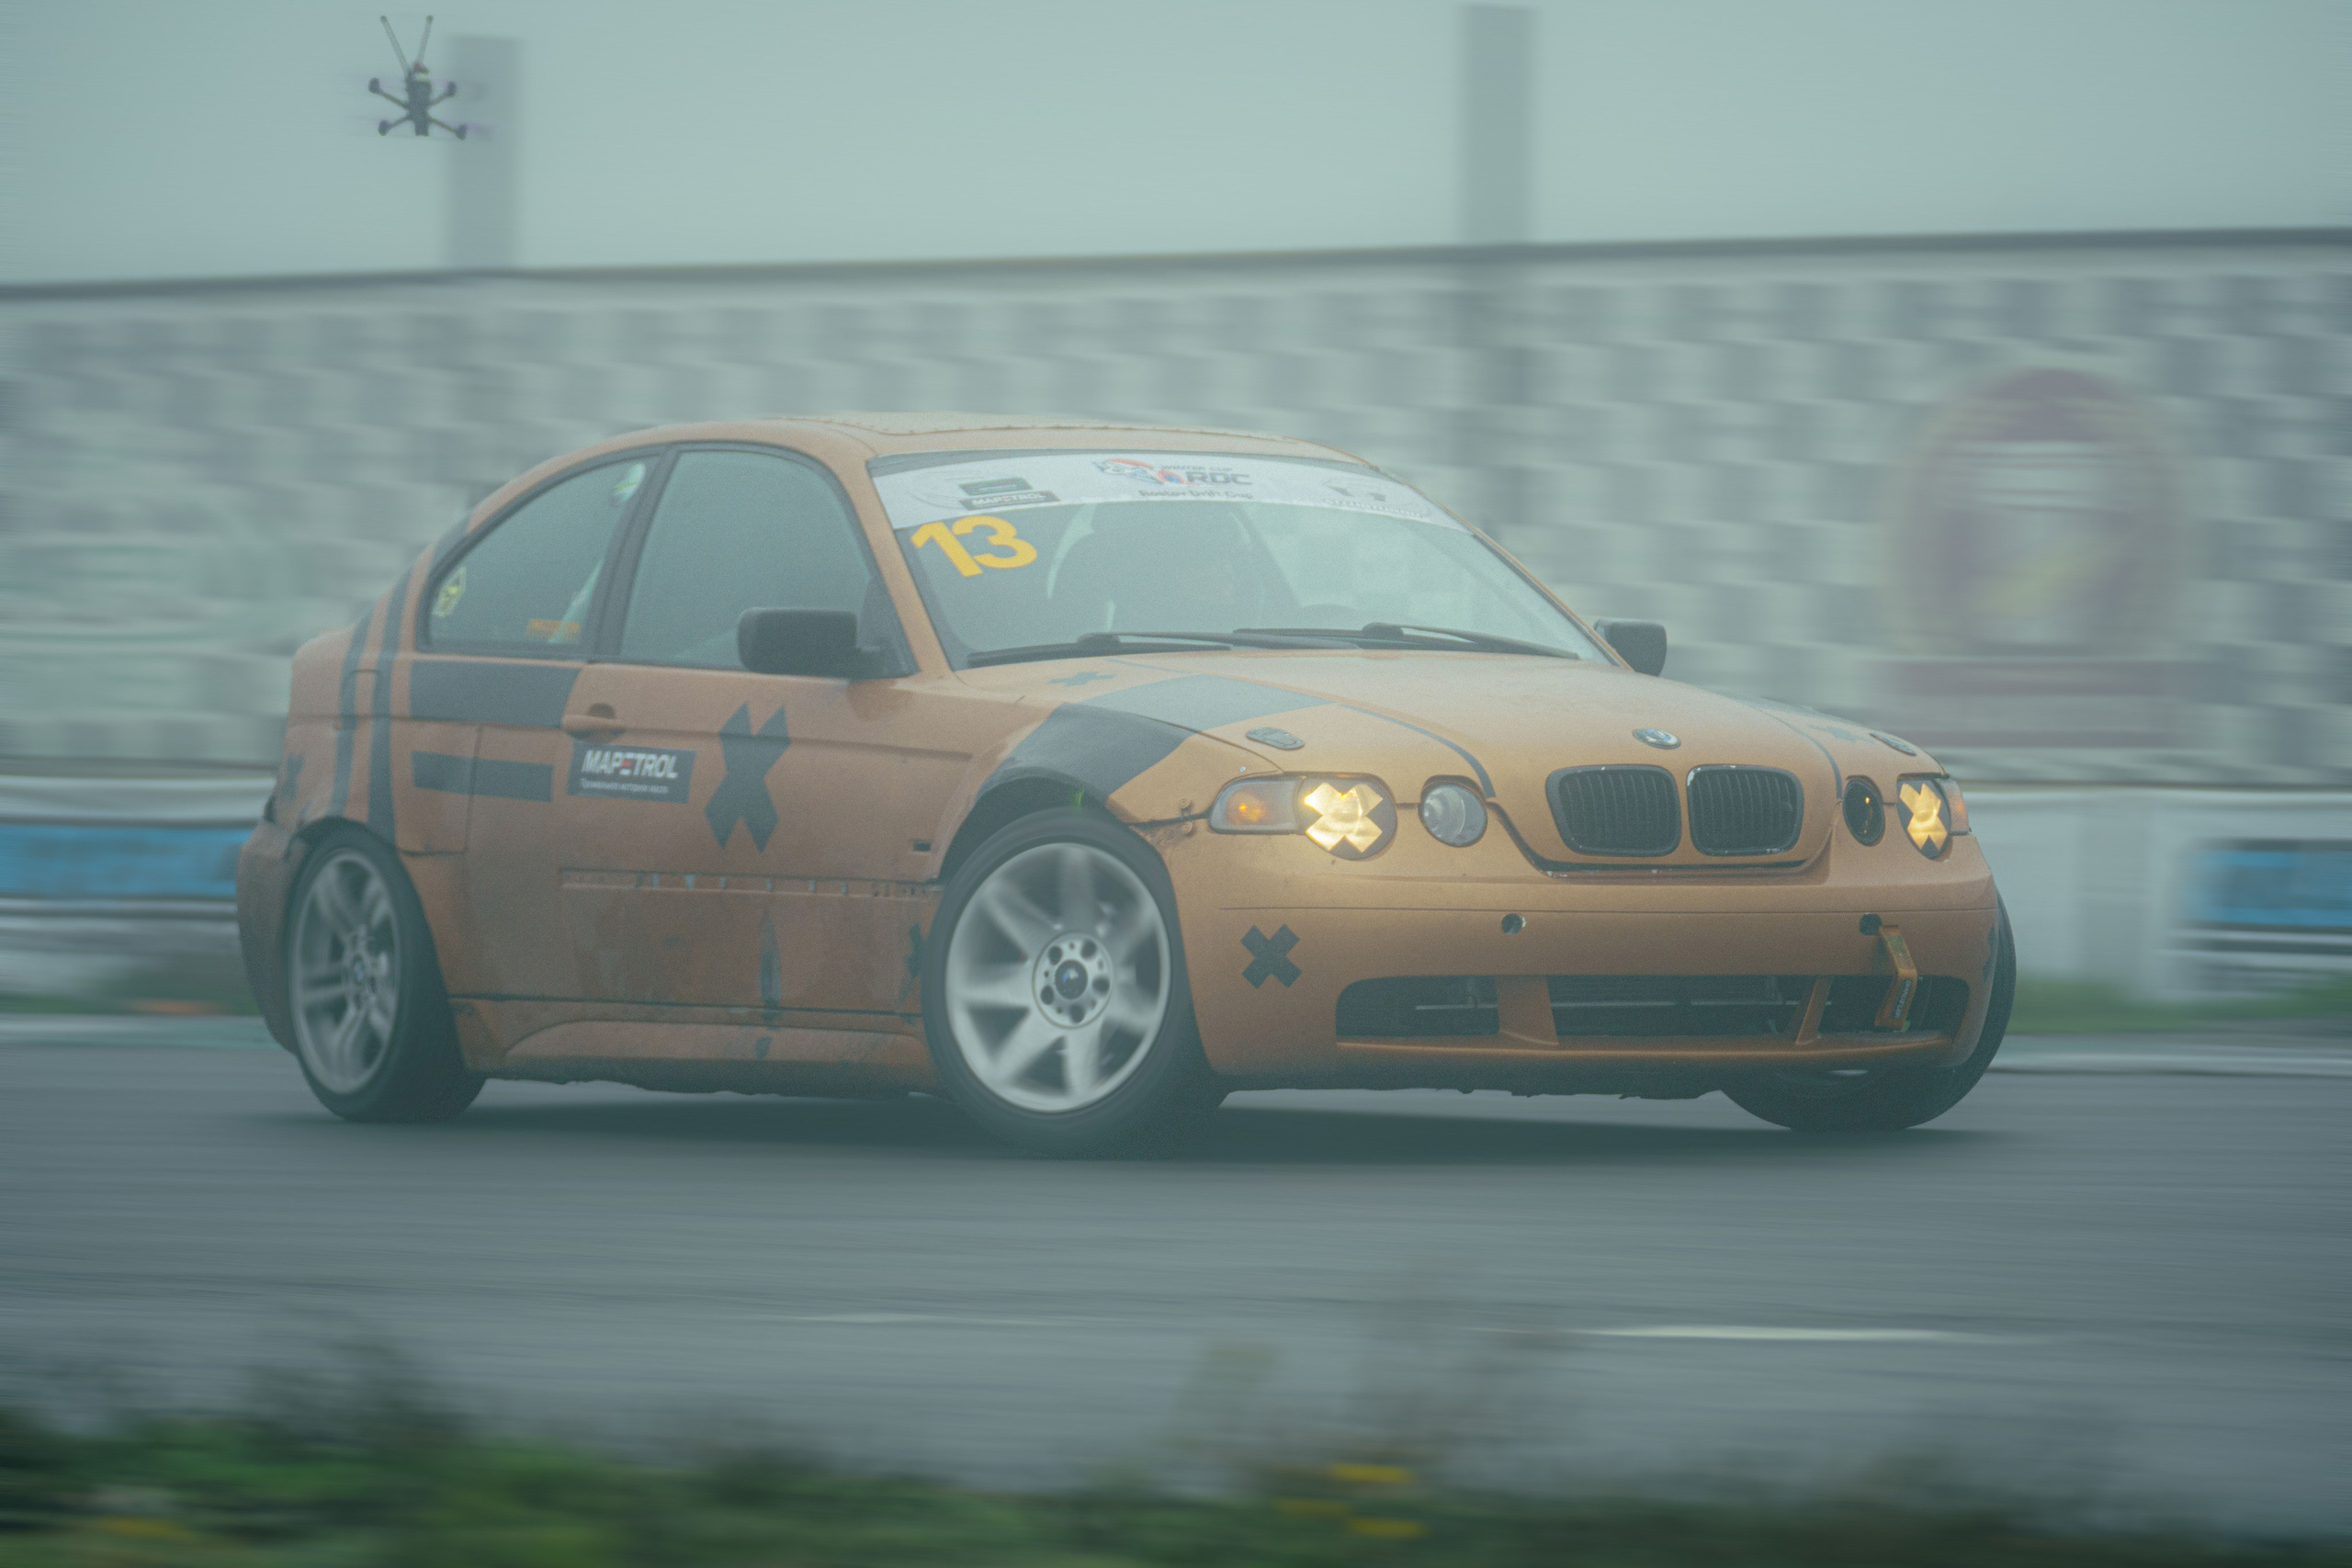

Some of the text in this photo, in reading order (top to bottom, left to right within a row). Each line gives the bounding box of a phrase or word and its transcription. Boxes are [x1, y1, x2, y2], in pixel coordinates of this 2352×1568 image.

[1185, 471, 1252, 485] RDC
[971, 492, 1046, 505] MAPETROL
[1225, 491, 1254, 500] Cup
[910, 514, 1038, 578] 13
[581, 749, 679, 779] MAPETROL
